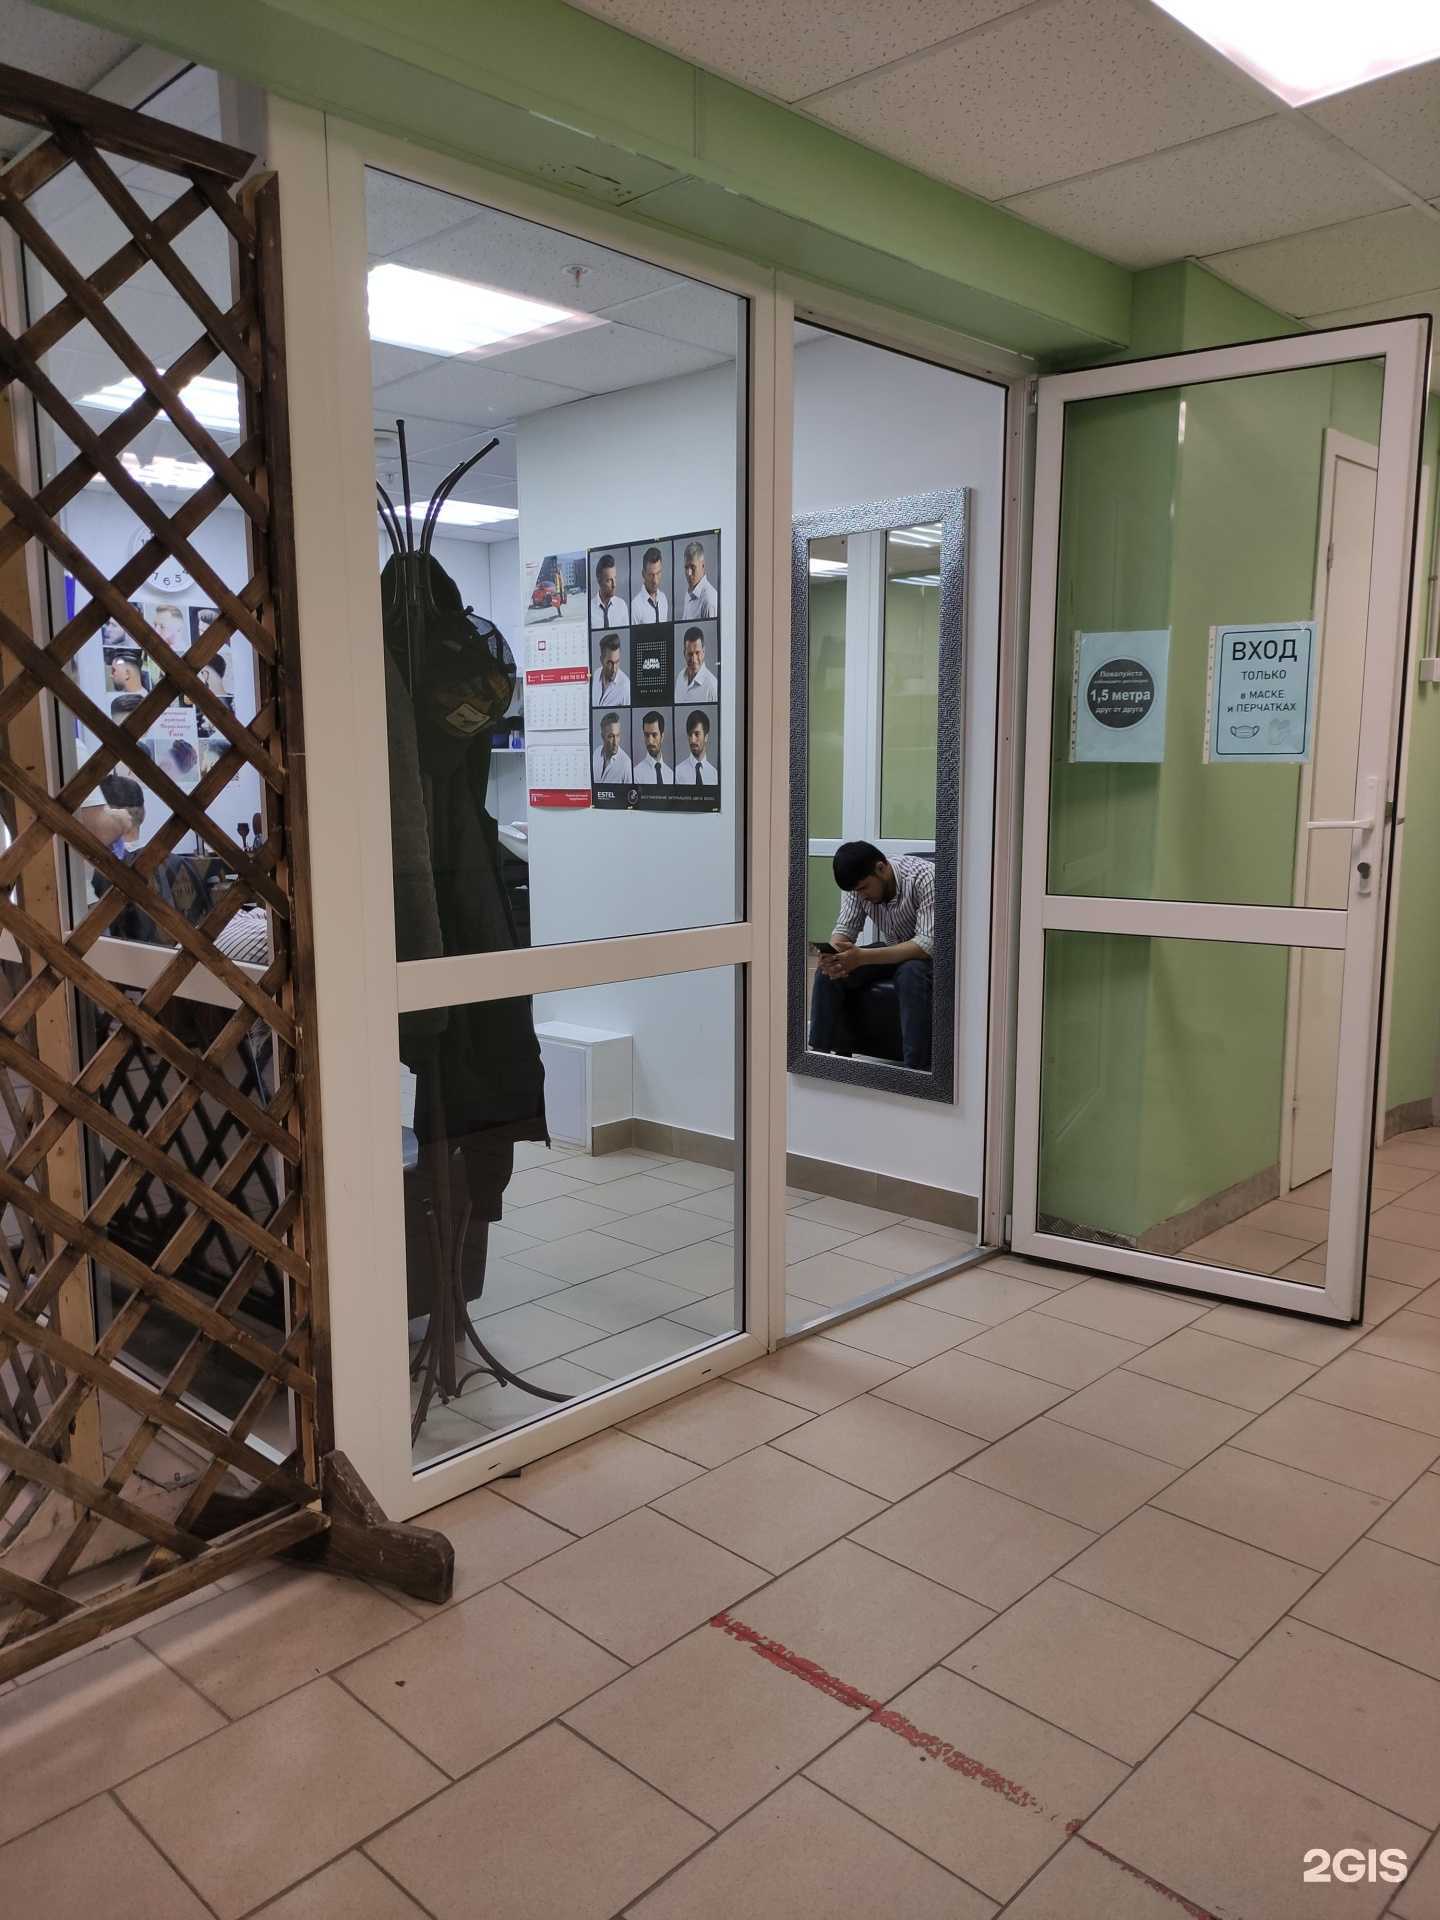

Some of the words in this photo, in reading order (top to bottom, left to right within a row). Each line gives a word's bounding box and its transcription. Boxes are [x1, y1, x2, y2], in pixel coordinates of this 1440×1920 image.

[163, 577, 171, 586] 6
[175, 574, 182, 583] 5
[1232, 639, 1298, 662] ВХОД
[1099, 670, 1144, 679] Пожалуйста
[1241, 670, 1287, 680] ТОЛЬКО
[1090, 689, 1109, 703] 1,5
[1112, 690, 1151, 703] метра
[1249, 690, 1285, 699] МАСКЕ
[1236, 702, 1297, 713] ПЕРЧАТКАХ
